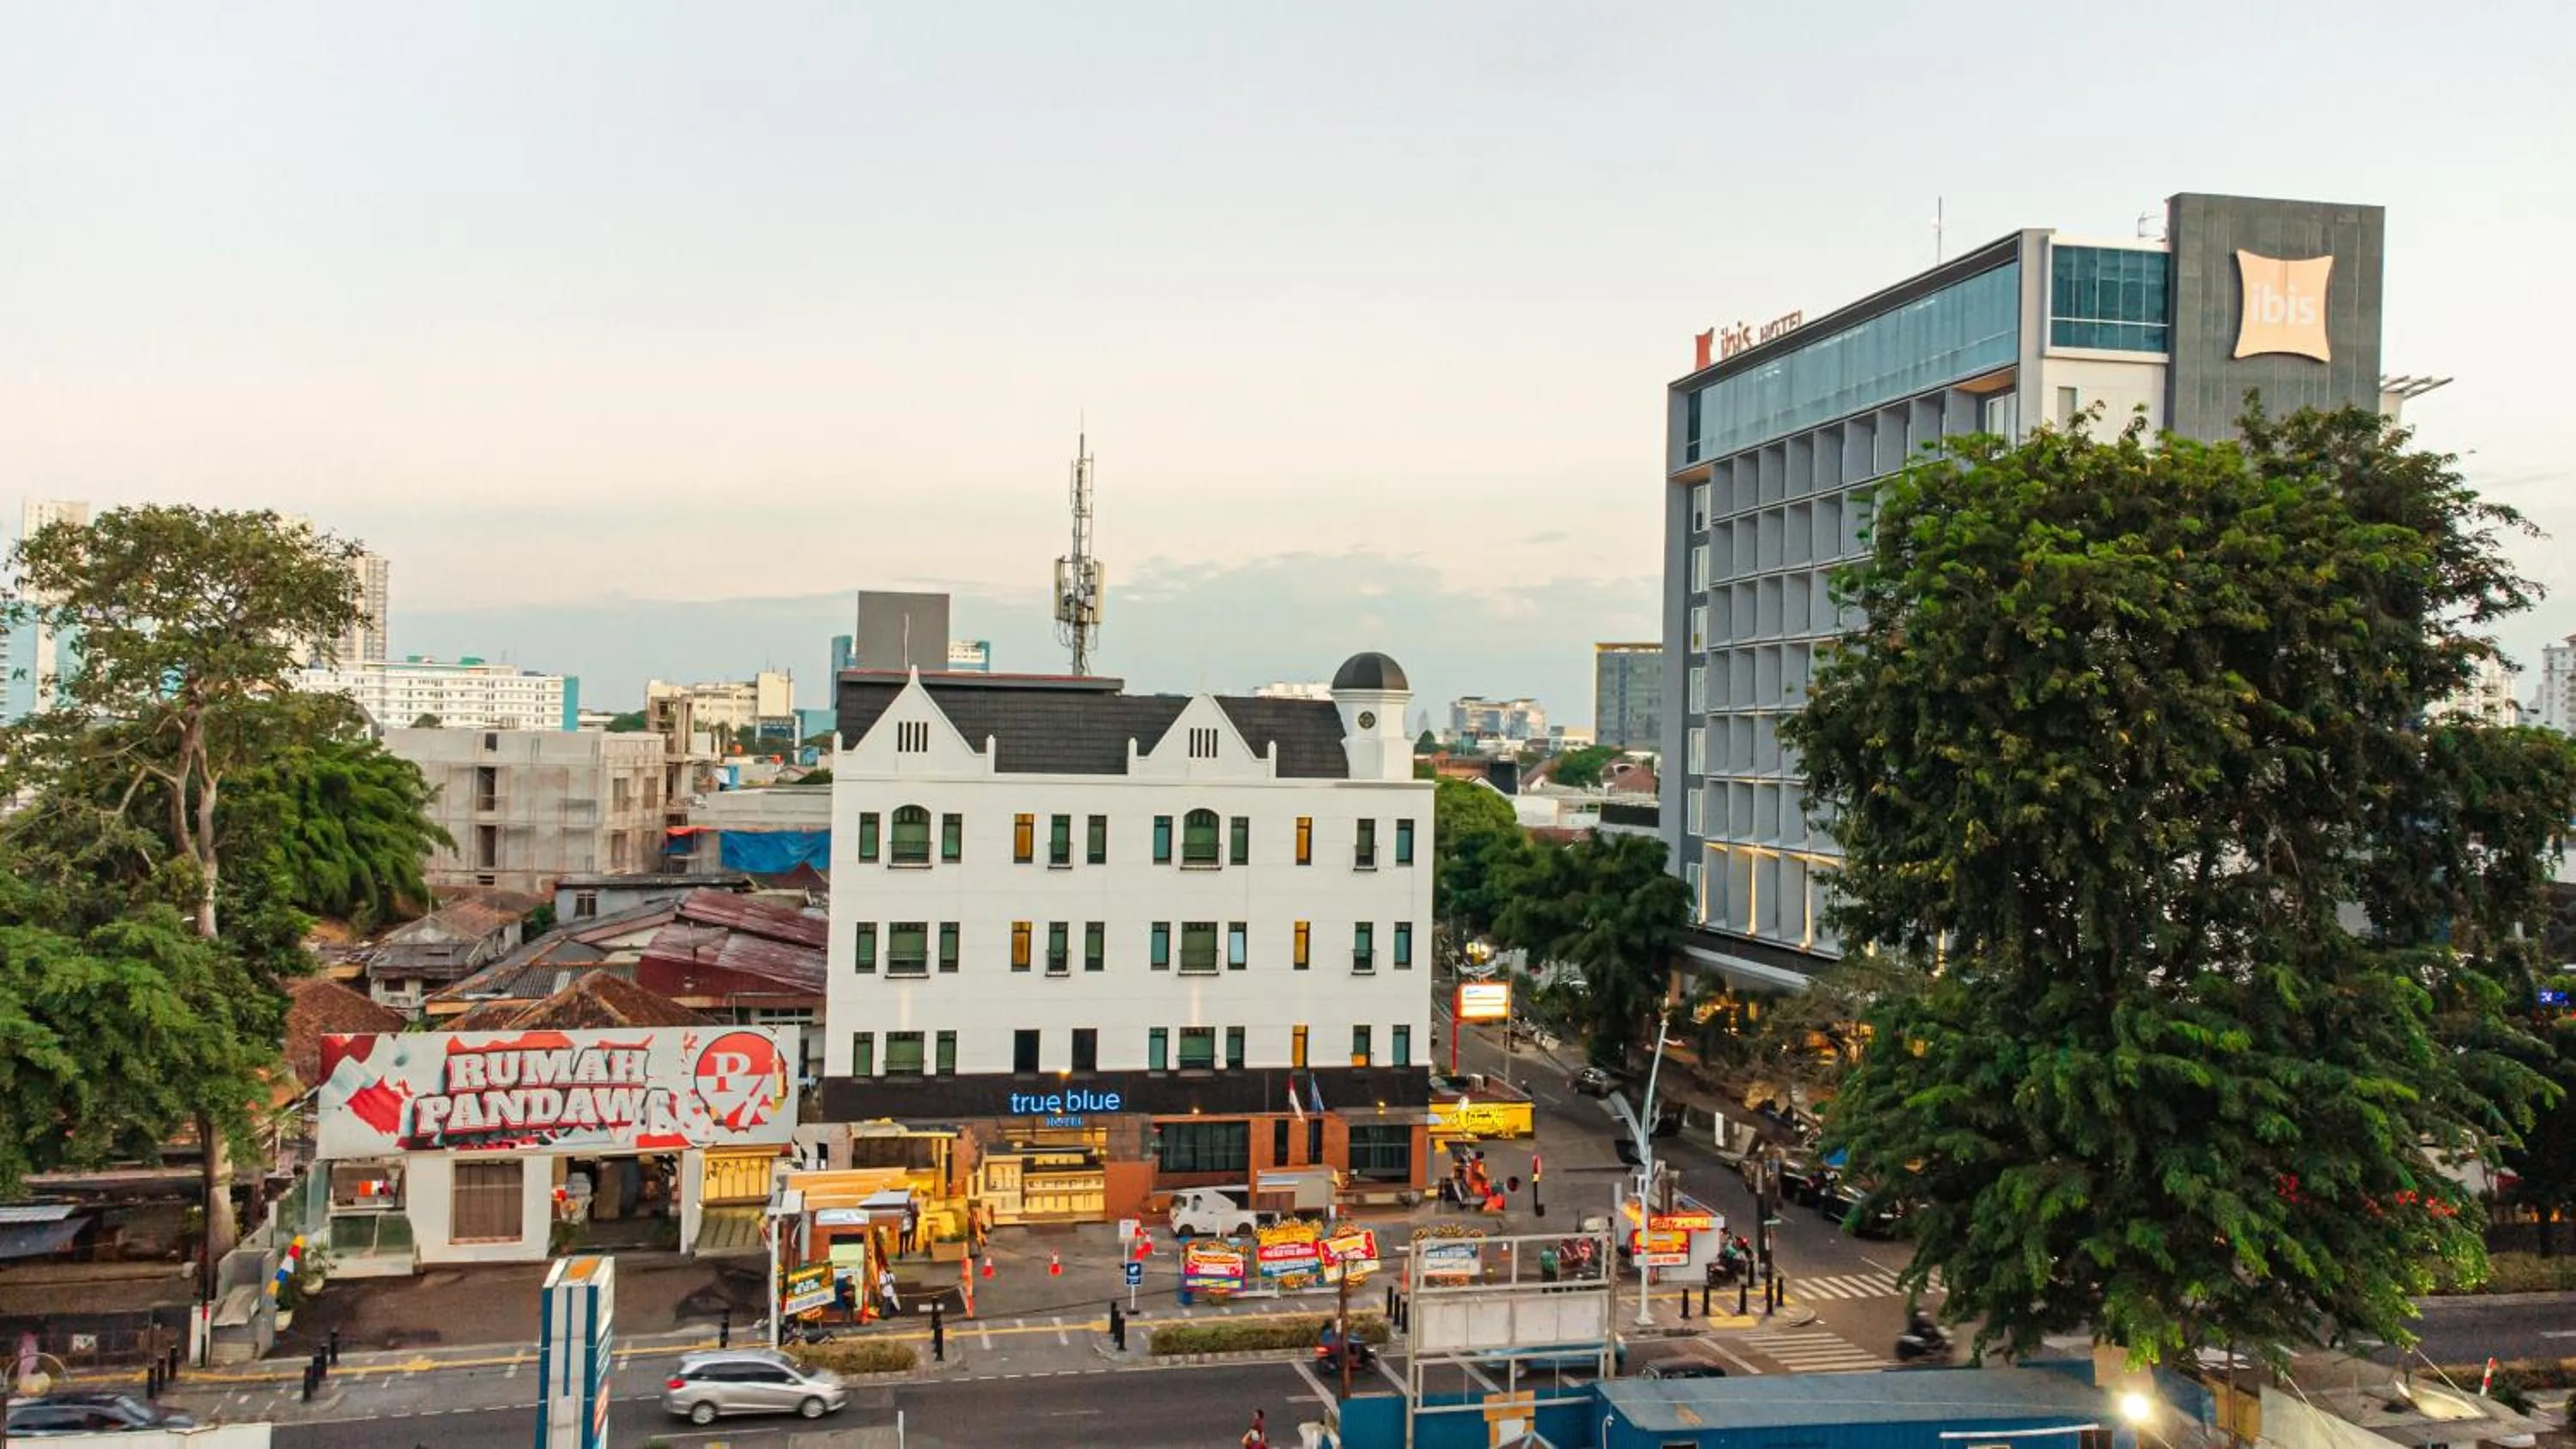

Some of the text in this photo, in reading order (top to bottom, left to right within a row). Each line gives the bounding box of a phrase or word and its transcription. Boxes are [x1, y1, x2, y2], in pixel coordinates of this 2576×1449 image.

[2250, 282, 2315, 326] ibis
[447, 1047, 648, 1092] RUMAH
[1011, 1088, 1121, 1113] true blue
